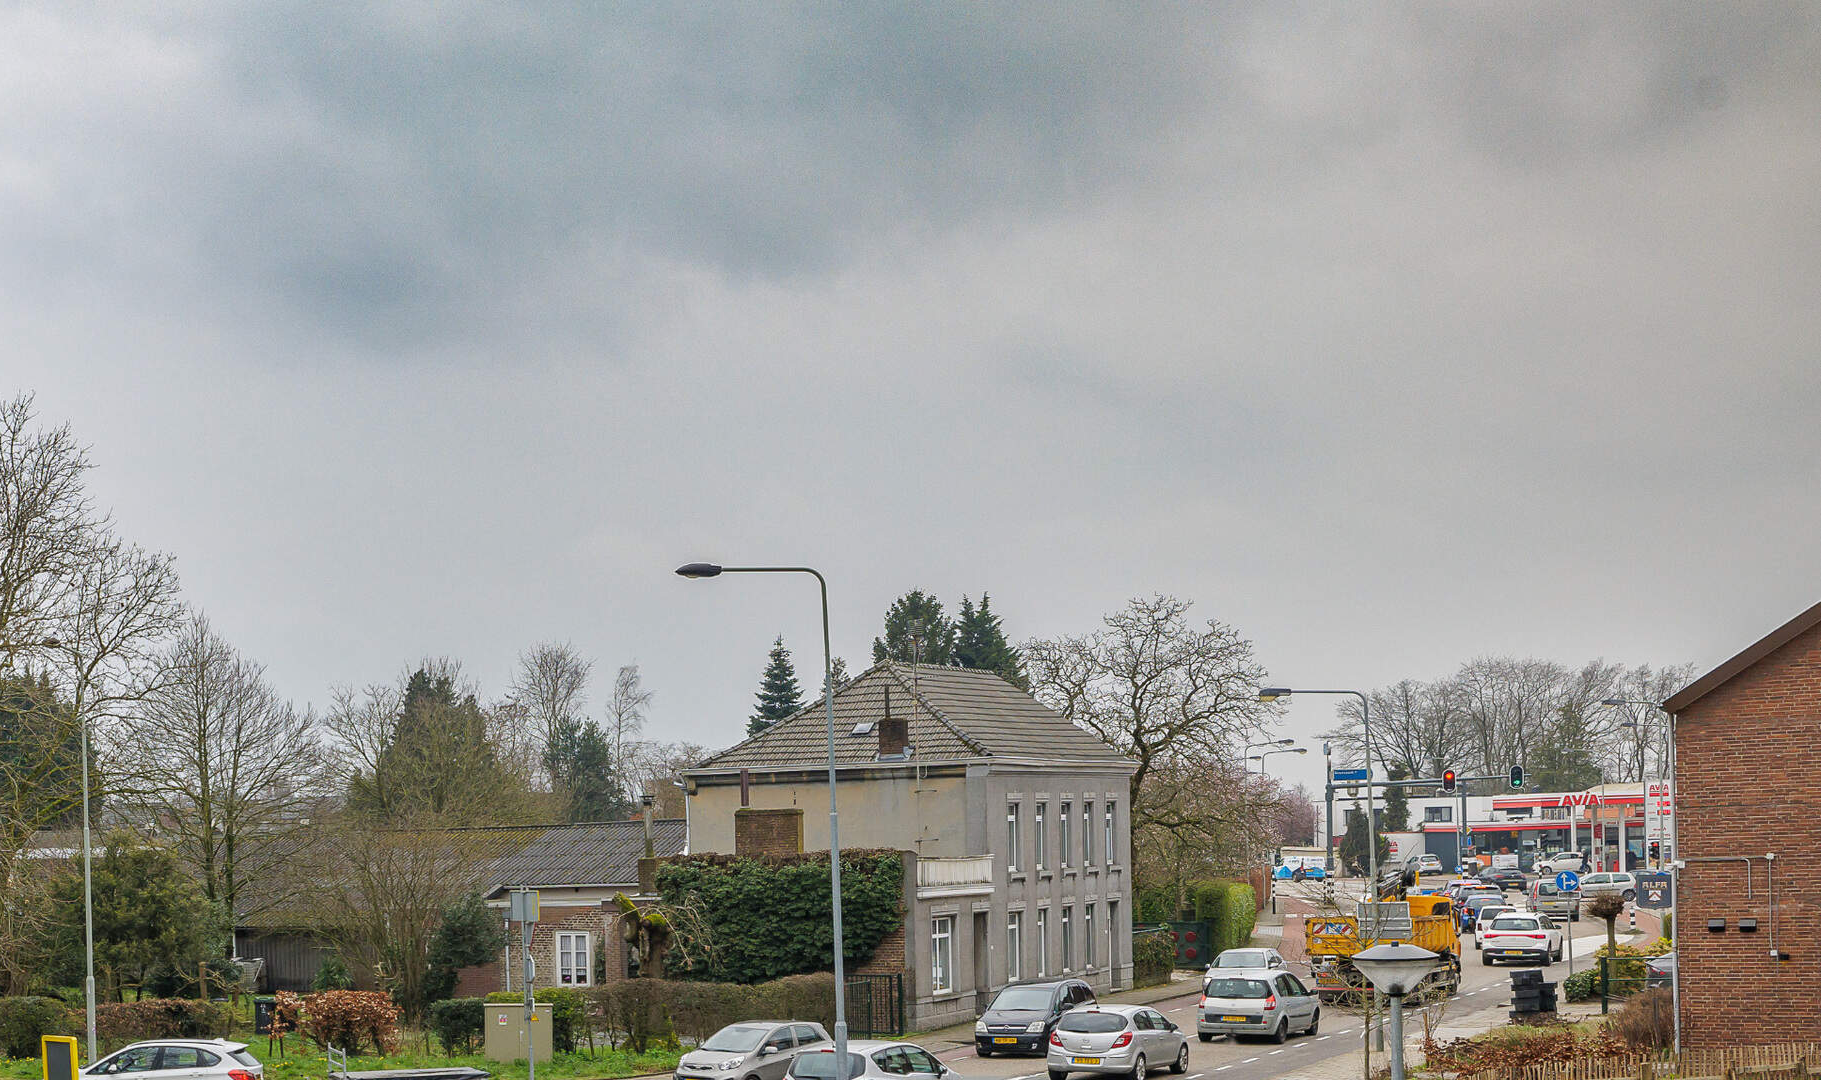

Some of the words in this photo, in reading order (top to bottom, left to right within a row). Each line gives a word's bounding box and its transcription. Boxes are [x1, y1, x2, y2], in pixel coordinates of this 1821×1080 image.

[1649, 784, 1669, 792] AVA
[1562, 791, 1600, 806] AVIA
[1642, 881, 1668, 889] ALFA
